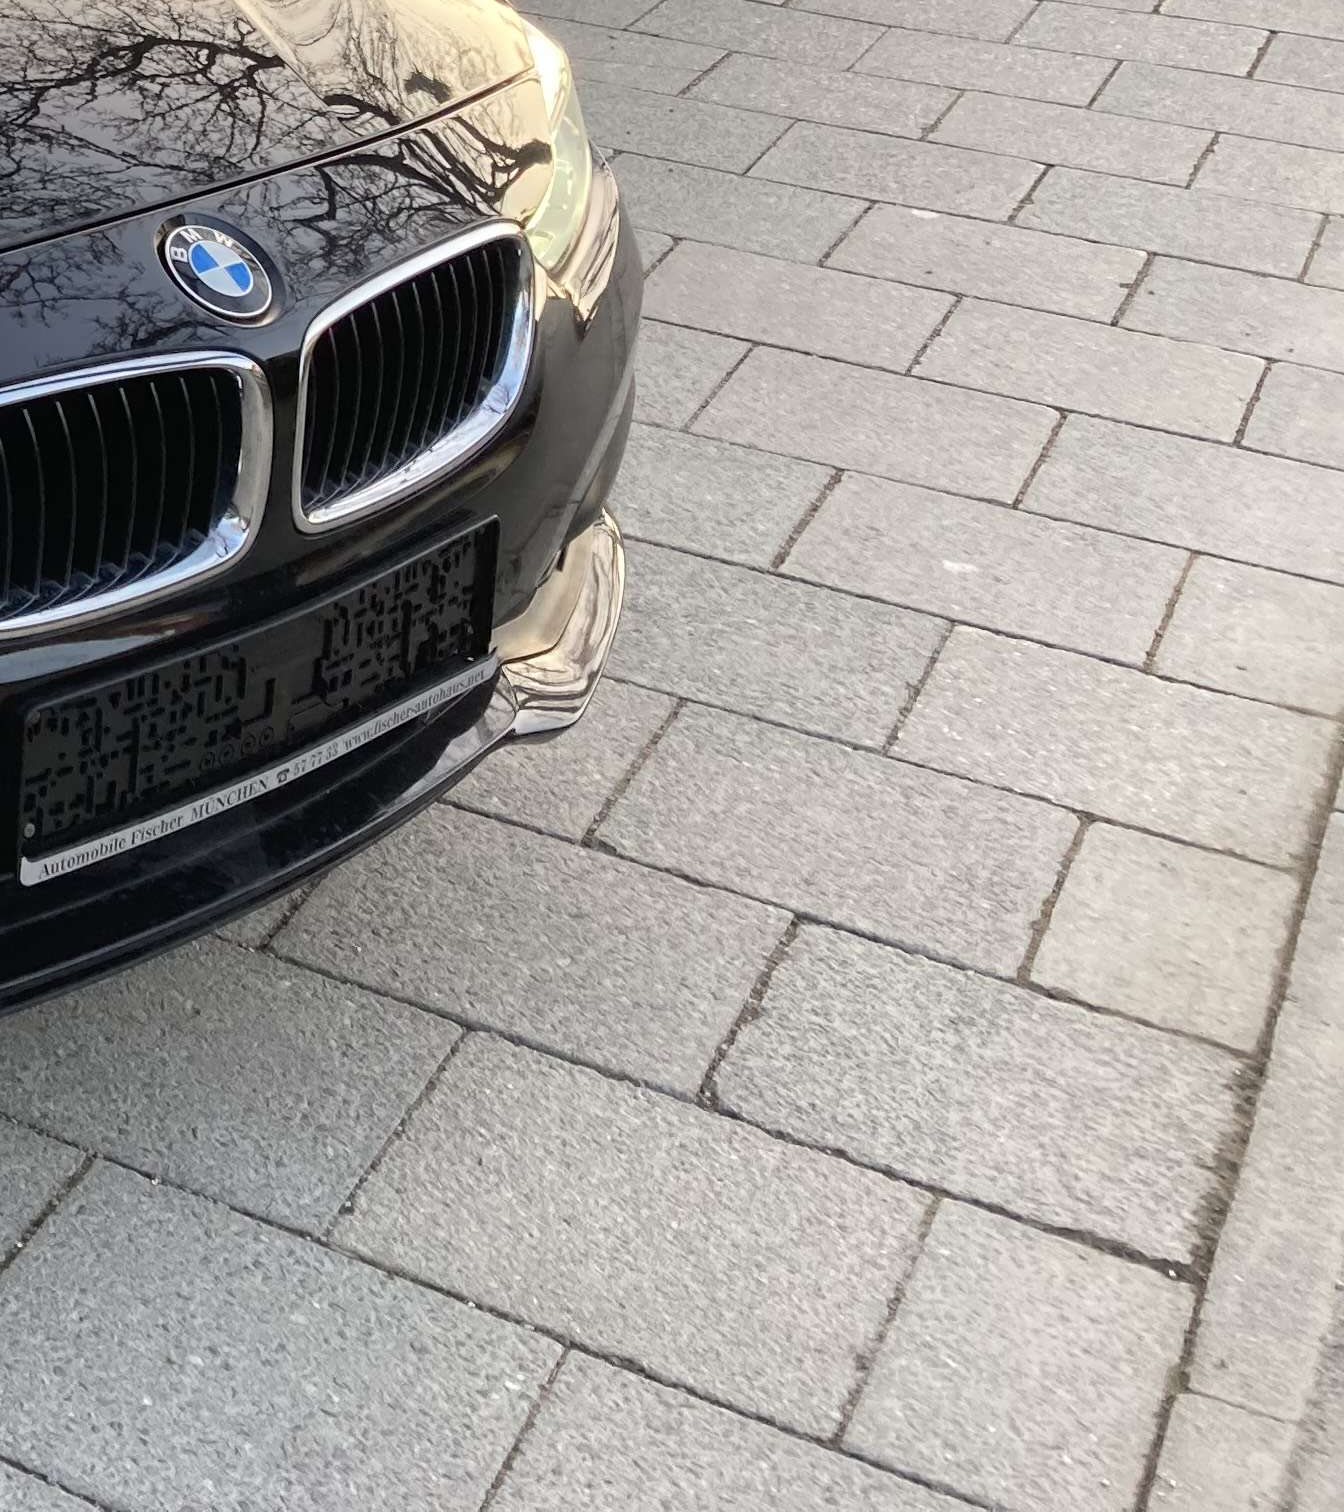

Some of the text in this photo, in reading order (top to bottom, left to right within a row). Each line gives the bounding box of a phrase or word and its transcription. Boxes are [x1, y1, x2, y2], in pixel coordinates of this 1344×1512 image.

[170, 228, 234, 263] BMW
[38, 835, 126, 880] Automobile
[130, 815, 185, 846] Fischer
[190, 776, 270, 823] MÜNCHEN
